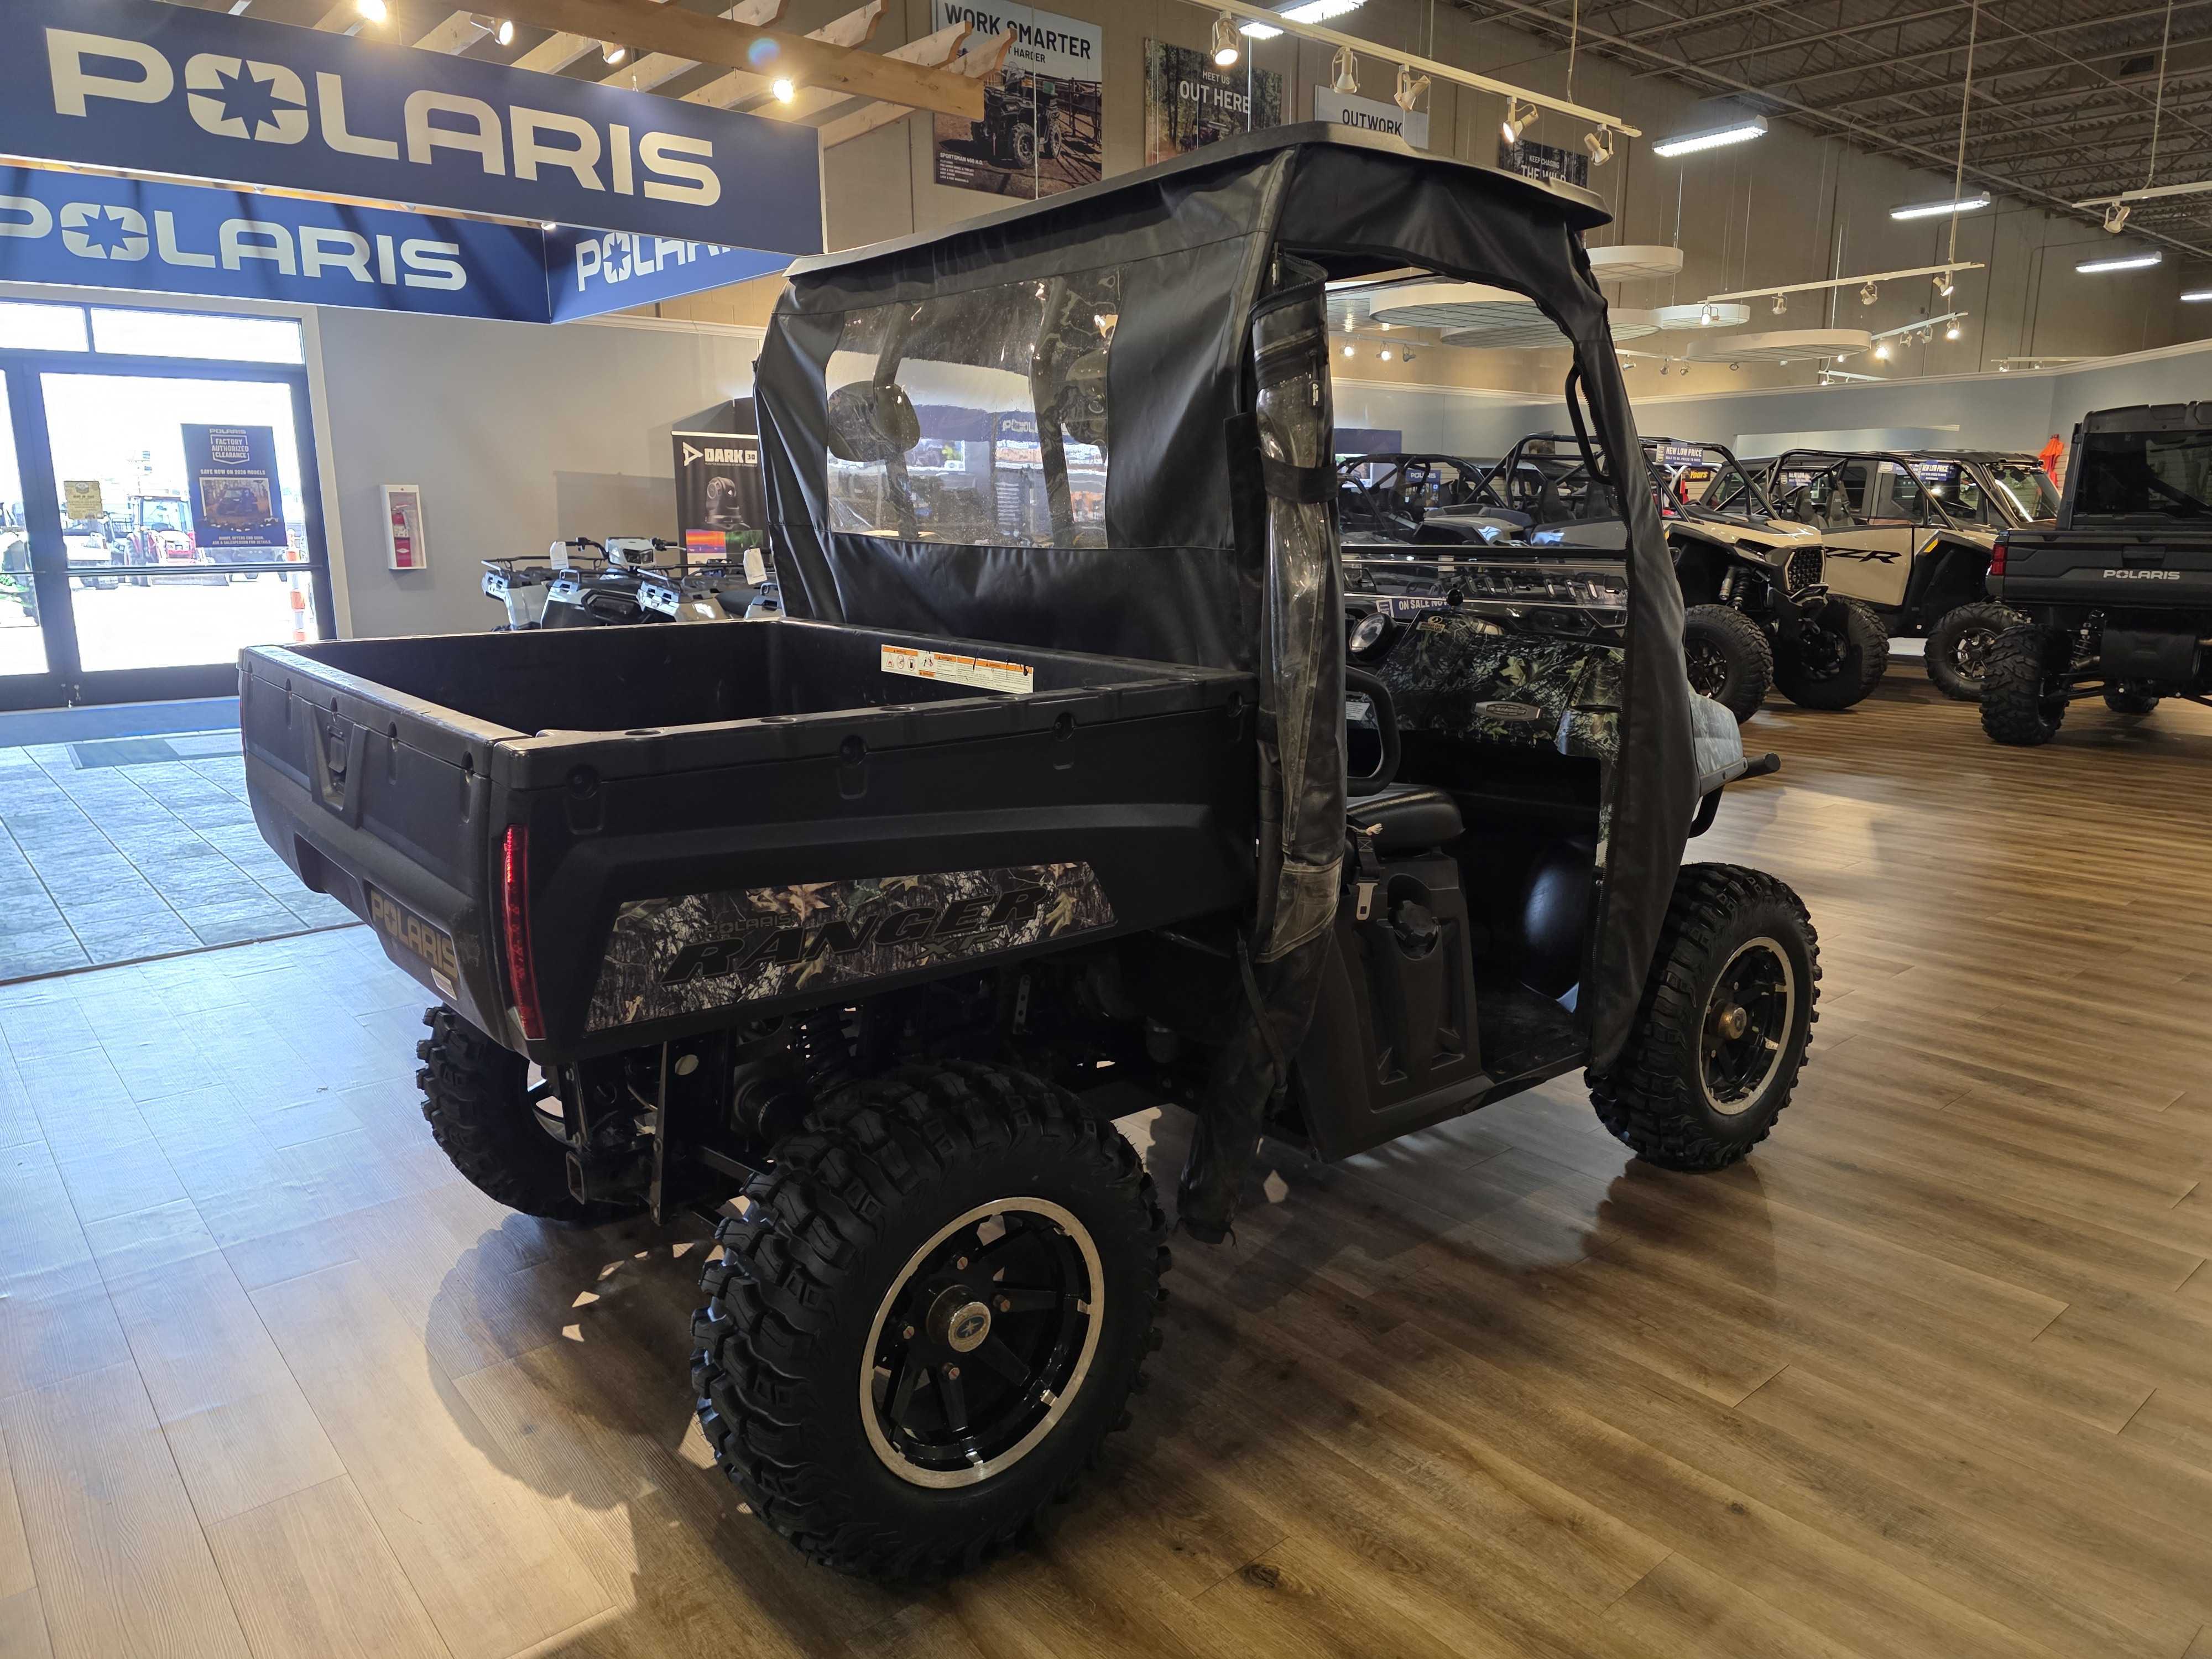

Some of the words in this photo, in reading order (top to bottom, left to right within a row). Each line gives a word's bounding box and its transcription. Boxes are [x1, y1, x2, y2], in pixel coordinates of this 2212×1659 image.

[944, 3, 1001, 35] WORK
[1202, 70, 1220, 82] MEET
[1221, 72, 1230, 85] US
[1180, 80, 1210, 103] OUT
[1214, 88, 1250, 114] HERE
[46, 28, 721, 206] POLARIS
[1343, 109, 1402, 138] OUTWORK
[1529, 155, 1540, 164] KEEP
[1521, 165, 1540, 180] THE
[0, 195, 467, 290] POLARIS
[576, 232, 731, 292] POLA
[705, 448, 744, 463] DARK
[1666, 446, 1677, 455] NEW
[1677, 447, 1688, 456] LOW
[1688, 449, 1702, 457] PRICE
[1690, 469, 1708, 478] Yours
[1825, 546, 1902, 564] ZR
[2103, 570, 2180, 580] POLARIS
[1399, 600, 1409, 611] ON
[1410, 598, 1430, 609] SALE
[371, 889, 458, 984] POLARIS
[659, 885, 1050, 986] RANGER
[703, 912, 793, 937] POLARIS
[911, 931, 1000, 961] XP
